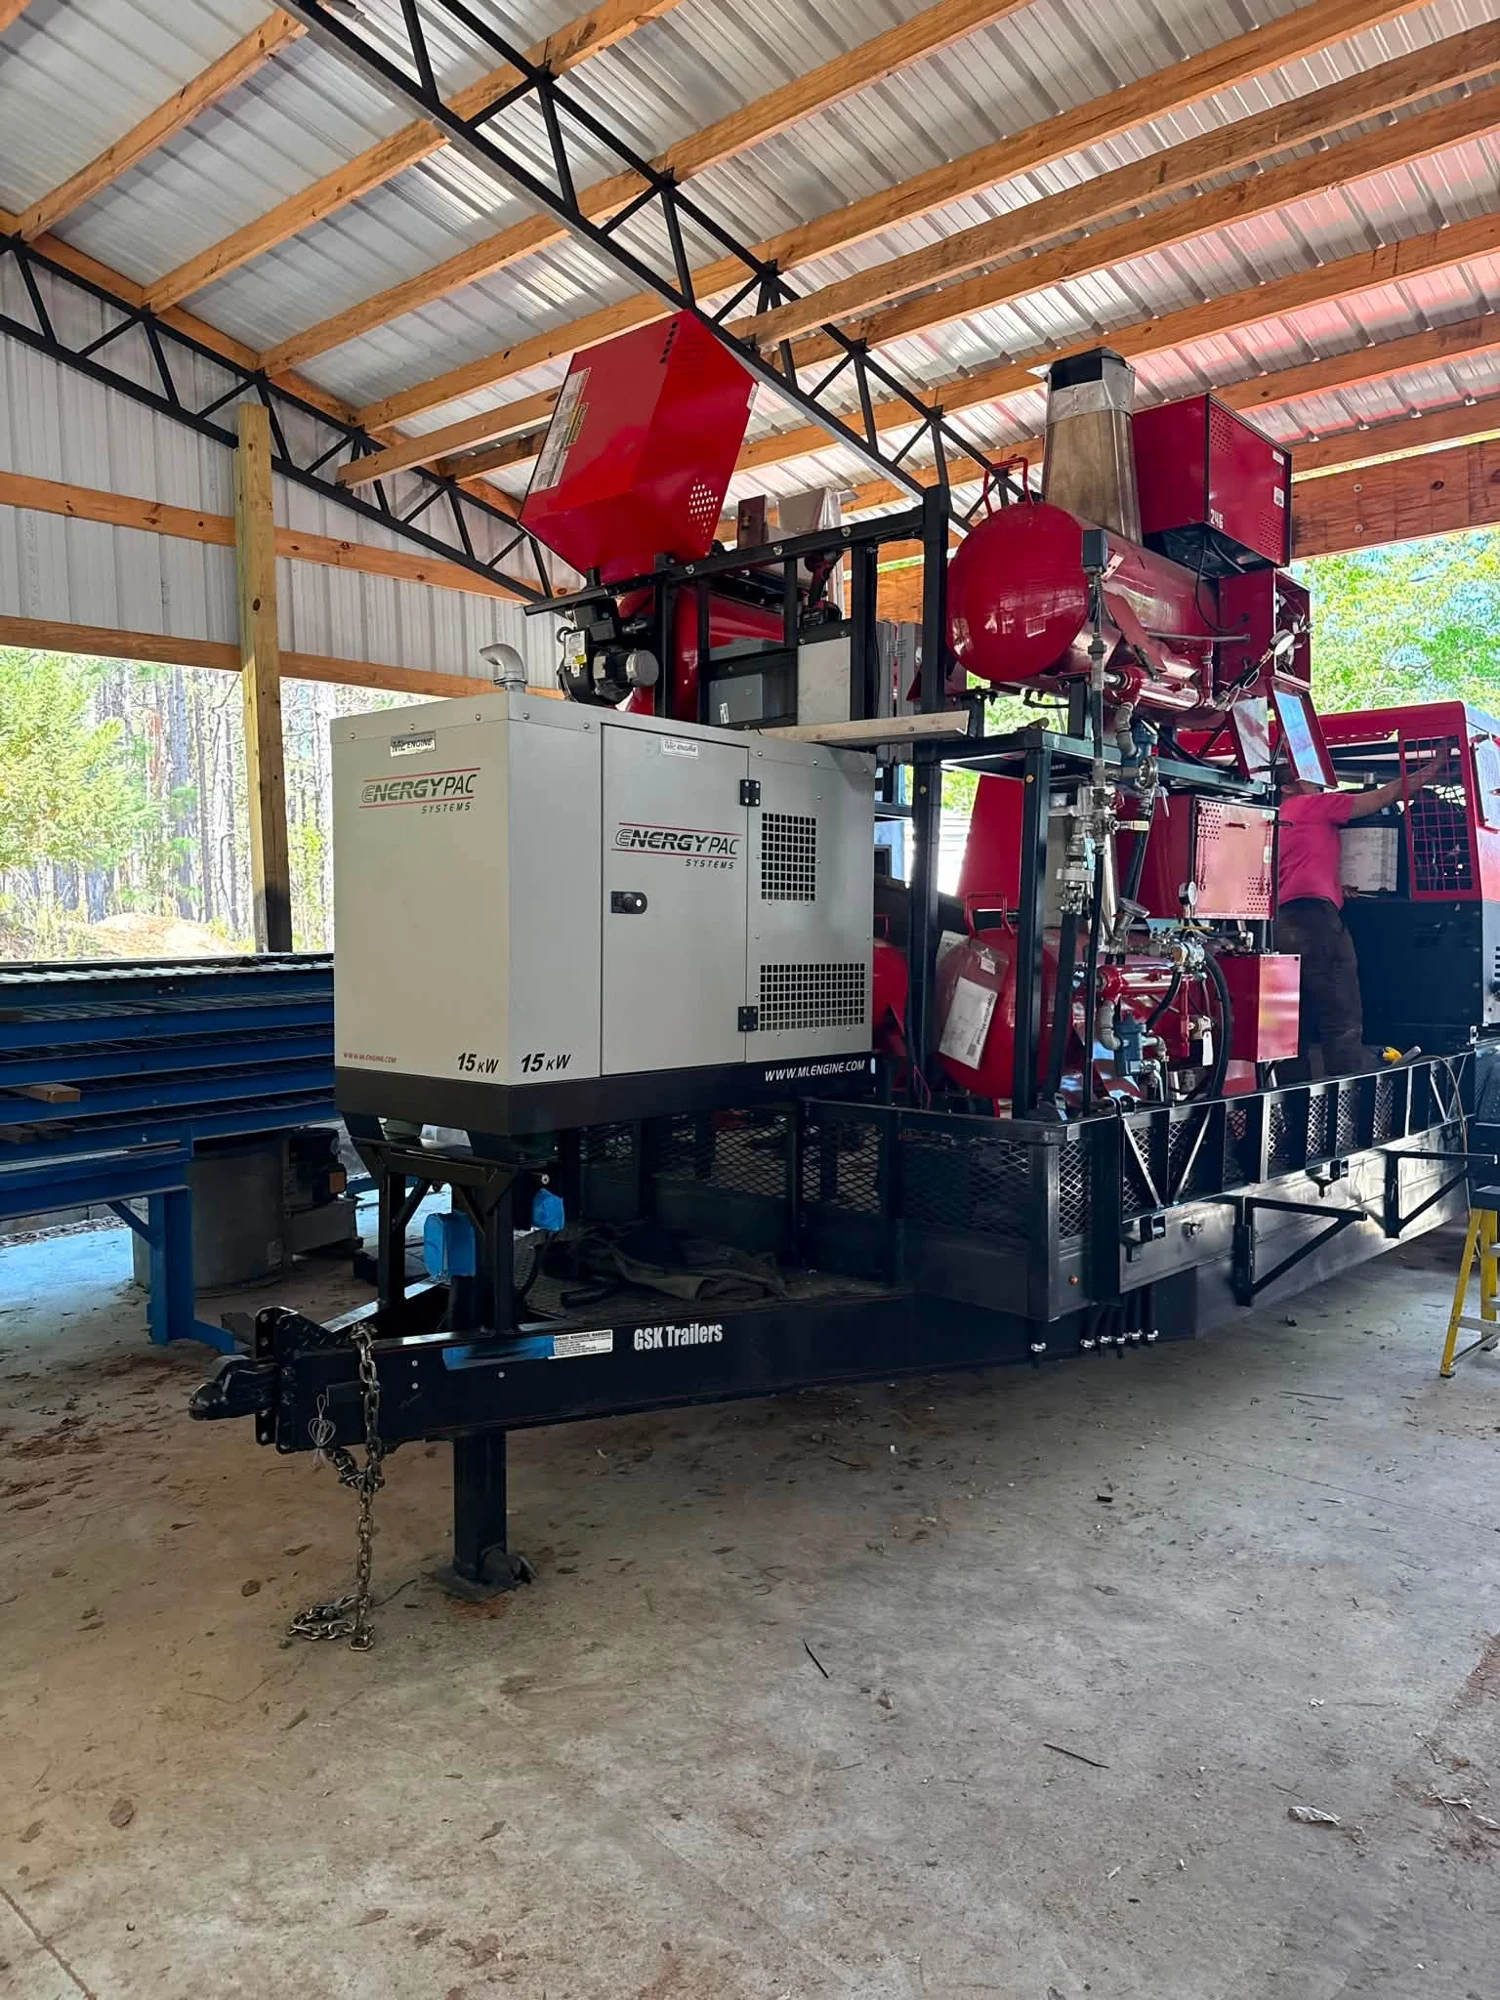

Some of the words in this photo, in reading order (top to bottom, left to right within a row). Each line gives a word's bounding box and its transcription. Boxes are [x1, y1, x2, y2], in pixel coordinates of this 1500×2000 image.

[421, 802, 471, 815] SYSTEMS
[685, 858, 735, 870] SYSTEMS
[457, 1052, 477, 1072] 15
[521, 1053, 546, 1073] 15
[765, 1060, 866, 1082] WWW.MLENGINE.COM
[633, 1326, 665, 1351] GSK
[665, 1323, 723, 1347] Trailers
